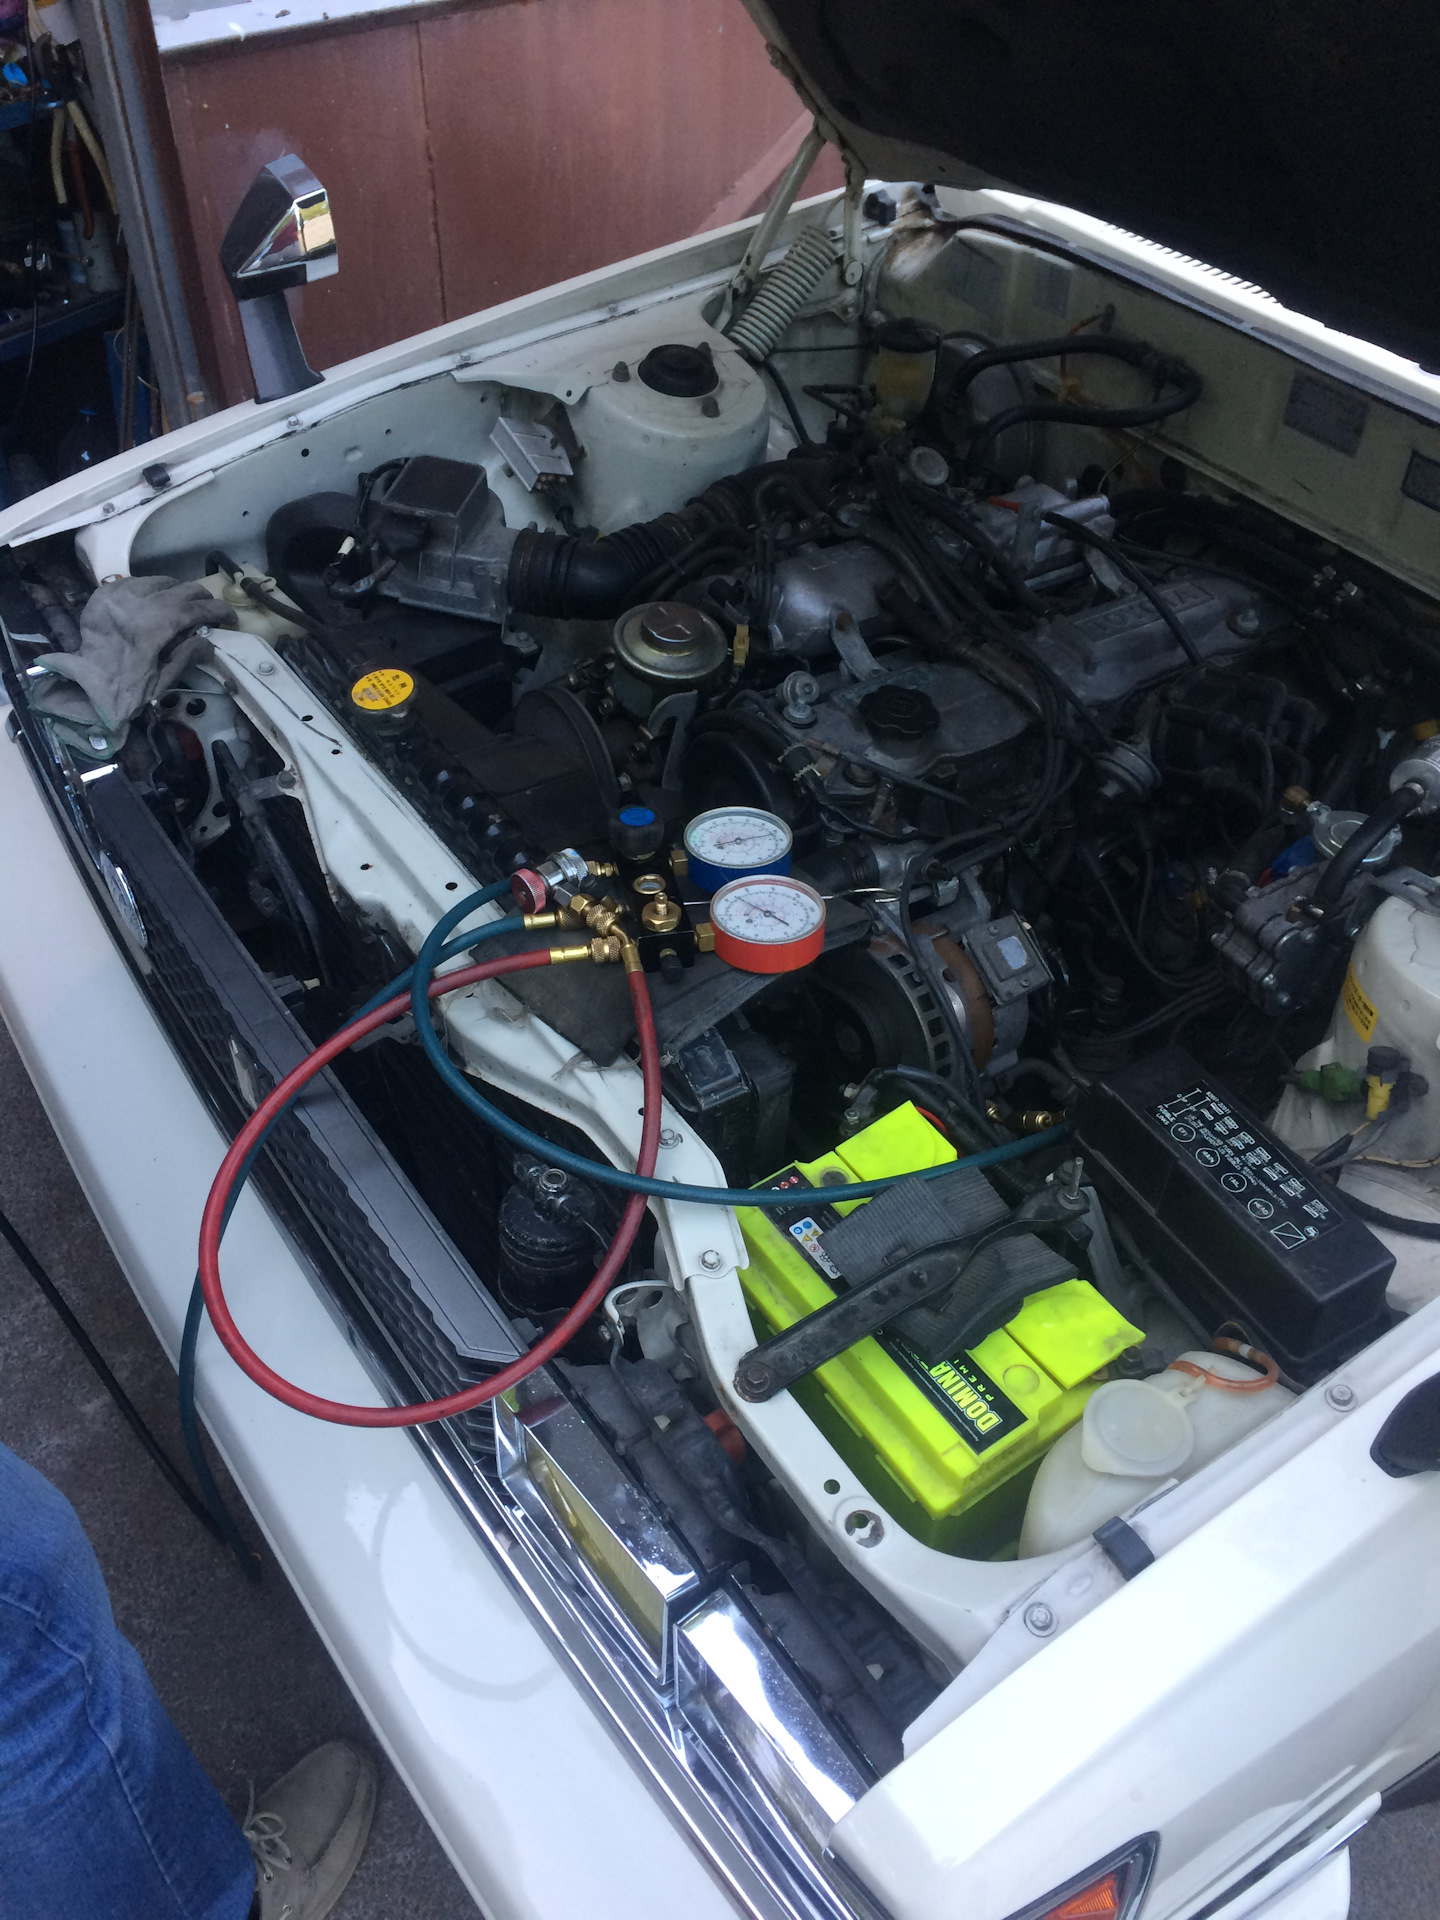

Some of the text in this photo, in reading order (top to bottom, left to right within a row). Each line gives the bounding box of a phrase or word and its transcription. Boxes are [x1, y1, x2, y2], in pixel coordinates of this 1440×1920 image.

[1177, 1126, 1188, 1137] EFI
[1202, 1150, 1215, 1163] MAIN
[1228, 1176, 1240, 1188] TAIL
[1253, 1201, 1269, 1215] HEAD
[953, 1359, 994, 1401] PREMI
[910, 1352, 1003, 1435] DOMINA
